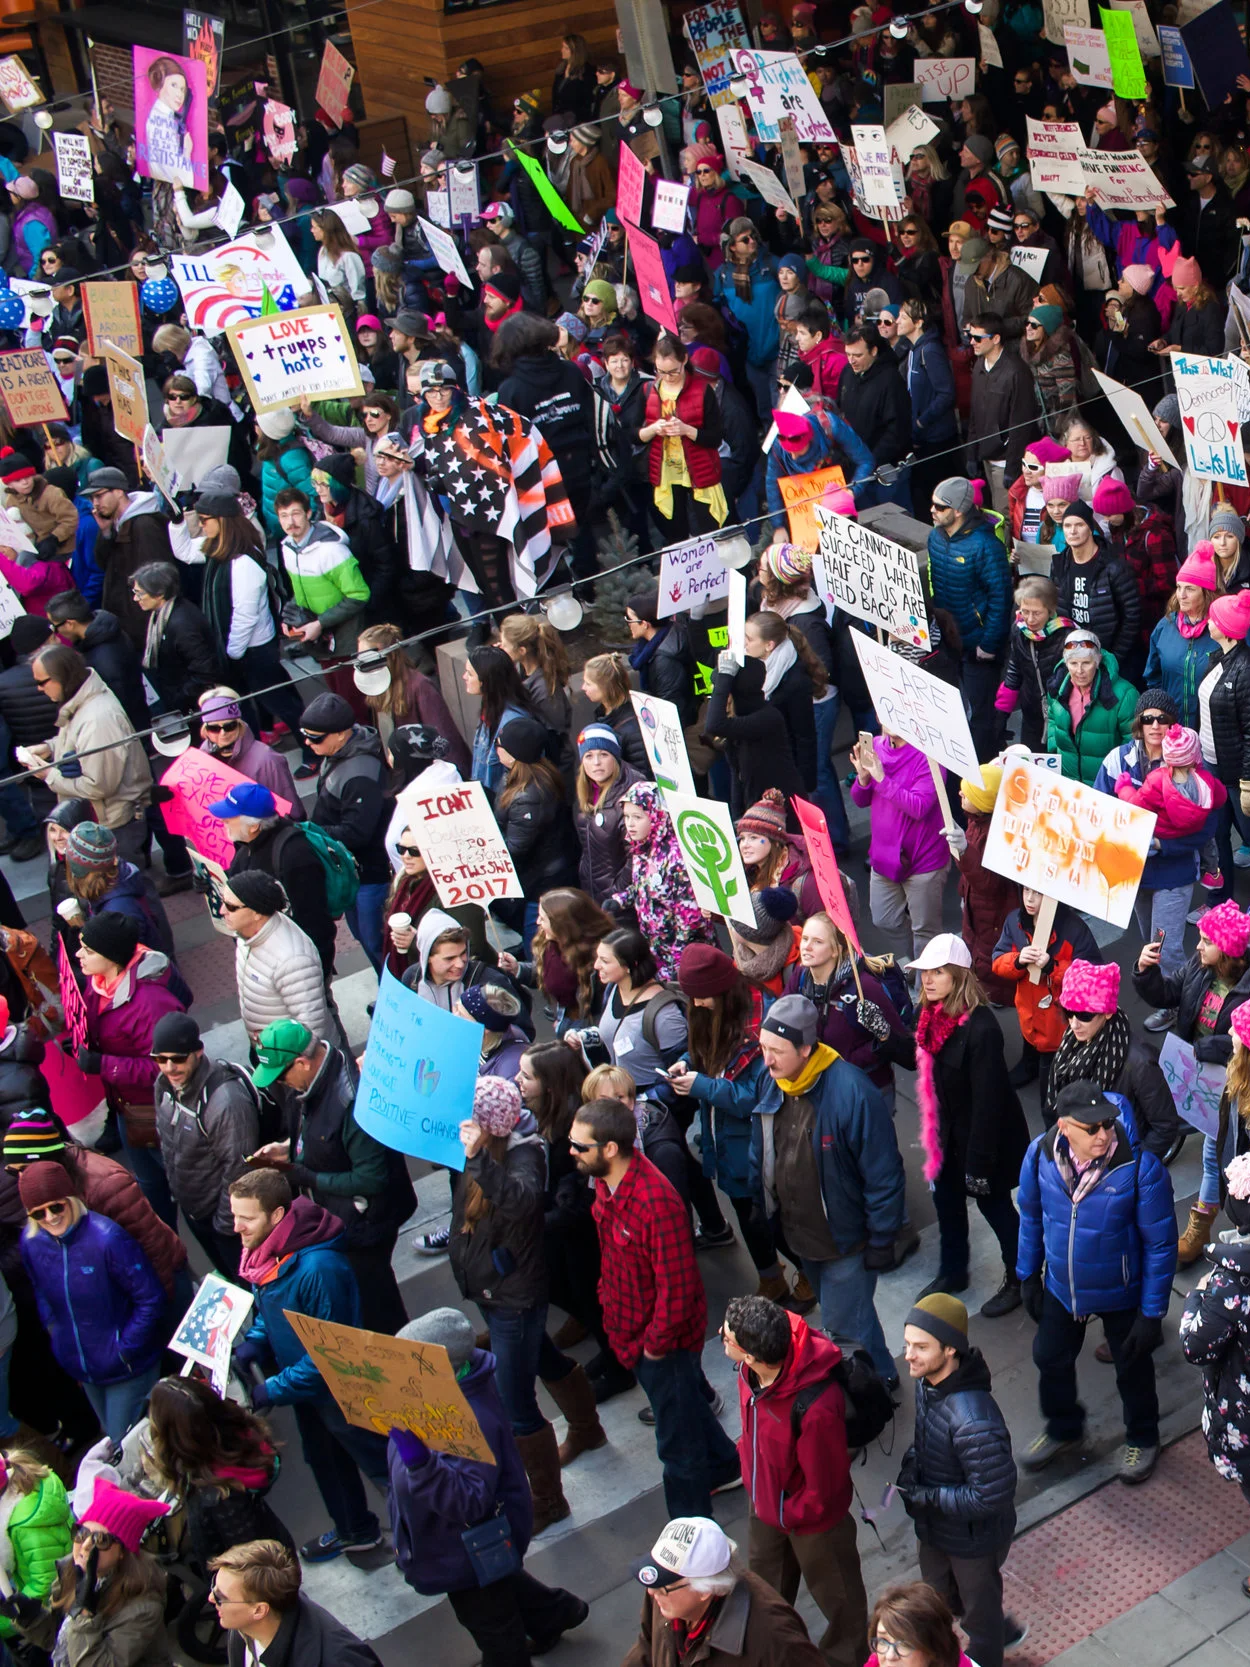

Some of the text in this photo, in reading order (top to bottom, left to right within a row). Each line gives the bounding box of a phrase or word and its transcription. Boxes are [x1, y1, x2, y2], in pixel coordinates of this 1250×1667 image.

[689, 12, 736, 38] PEOPLE
[702, 62, 725, 80] NOT
[753, 53, 807, 93] Rights
[937, 63, 971, 97] UP
[780, 94, 804, 111] are
[787, 112, 832, 141] Rights
[63, 138, 85, 147] WILL NOT
[180, 263, 216, 282] ILL
[269, 318, 313, 341] LOVE
[263, 336, 327, 360] trumps
[281, 352, 323, 376] hate
[1174, 356, 1235, 380] This What
[2, 371, 53, 390] IS A RIGHT
[1178, 381, 1236, 413] Democracy
[668, 542, 715, 566] Women
[818, 510, 919, 575] WE CANNOT ALL
[685, 560, 703, 575] are
[821, 531, 922, 597] SUCCEED WHEN
[688, 567, 728, 596] Perfect
[822, 553, 927, 620] HALF OF US ARE
[1074, 576, 1087, 592] BE
[825, 573, 897, 627] HELD BACK
[857, 641, 948, 714] WE ARE
[891, 687, 930, 723] THE
[880, 696, 969, 767] PEOPLE
[417, 798, 440, 821] I
[431, 859, 514, 884] For This Shit
[447, 878, 508, 906] 2017
[369, 1087, 418, 1126] POSITIVE
[660, 1546, 680, 1567] UCONN
